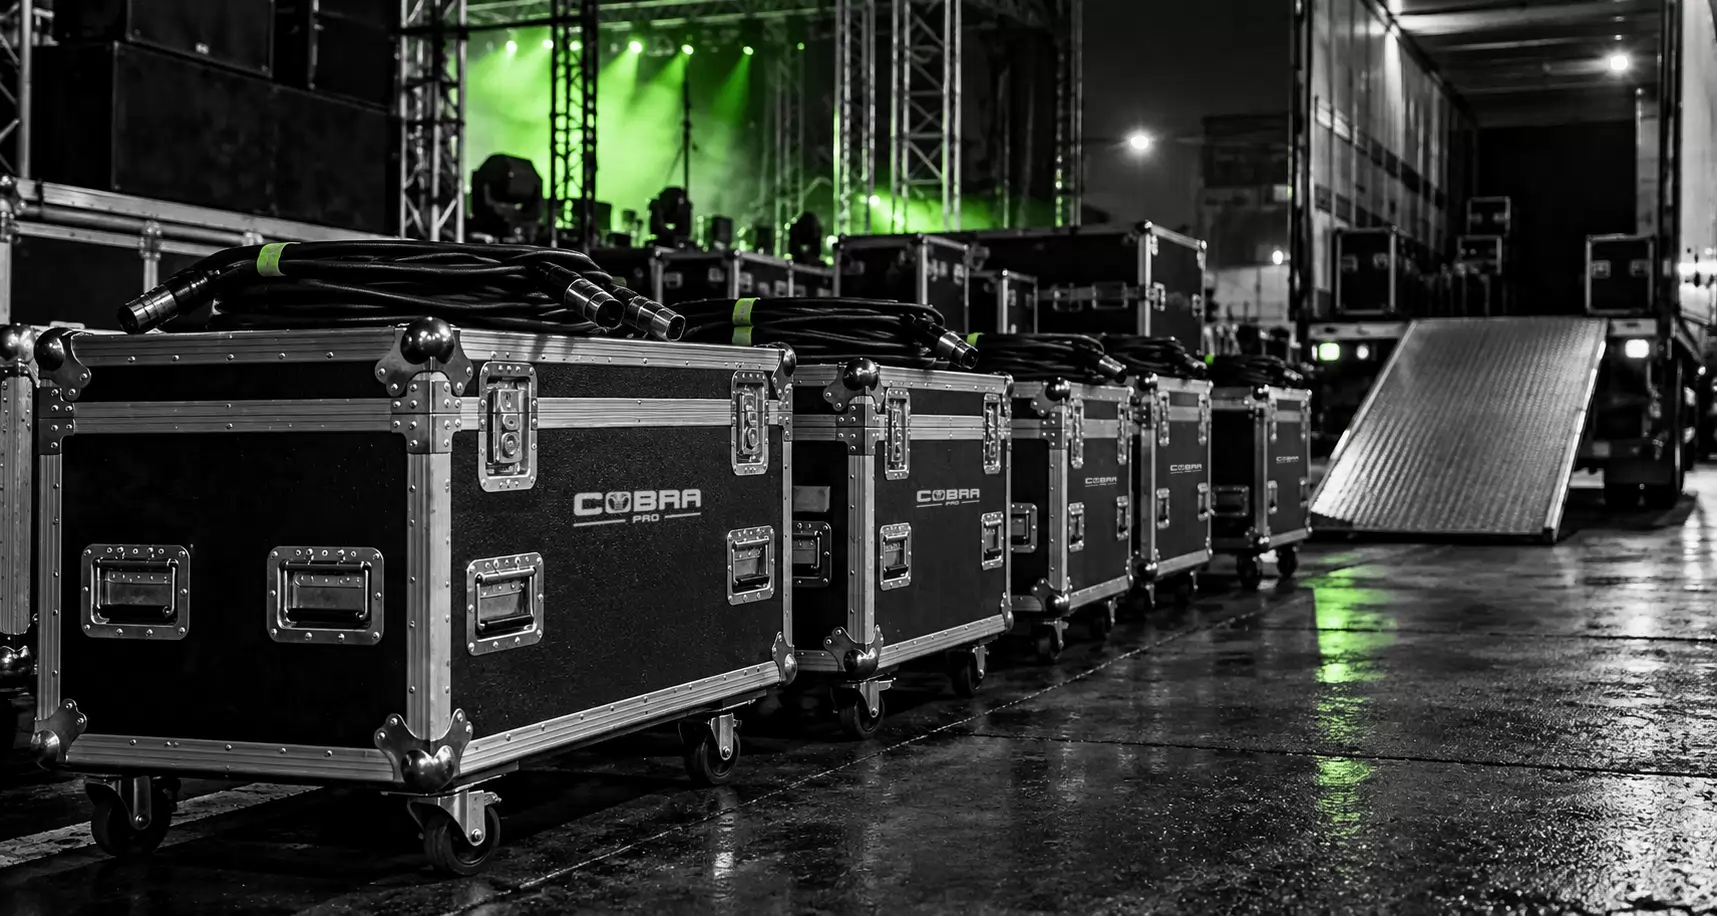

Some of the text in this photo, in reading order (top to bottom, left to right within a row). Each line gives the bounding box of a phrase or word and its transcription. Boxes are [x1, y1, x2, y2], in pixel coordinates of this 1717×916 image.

[916, 488, 980, 502] COBRA
[574, 489, 701, 516] COBRA
[632, 513, 659, 523] PRO
